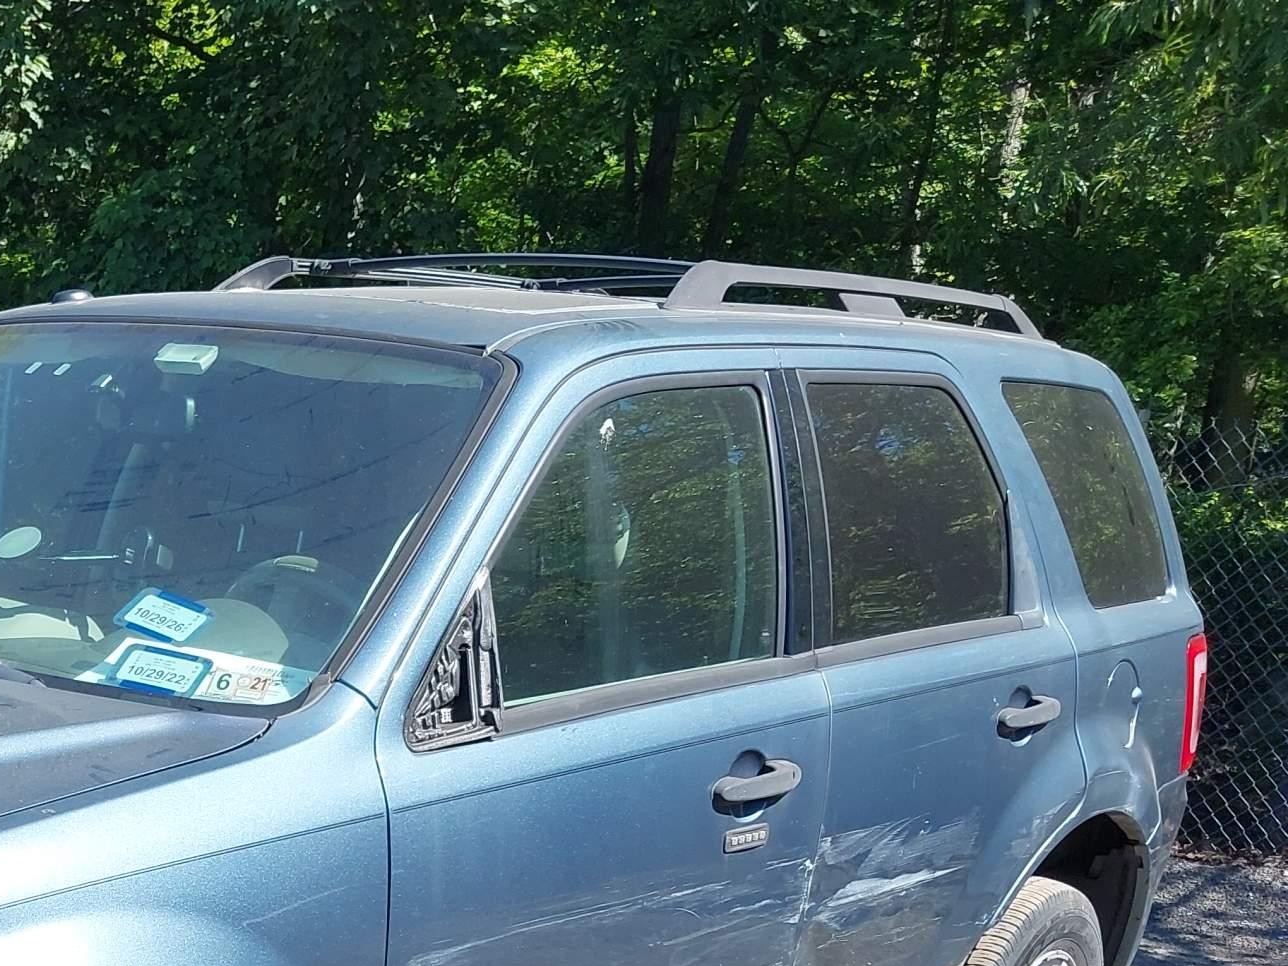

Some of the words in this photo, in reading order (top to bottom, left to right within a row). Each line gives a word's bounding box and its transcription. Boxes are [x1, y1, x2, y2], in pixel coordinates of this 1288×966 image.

[133, 606, 185, 632] 10/29/26
[127, 664, 186, 685] 10/29/22
[216, 673, 232, 690] 6
